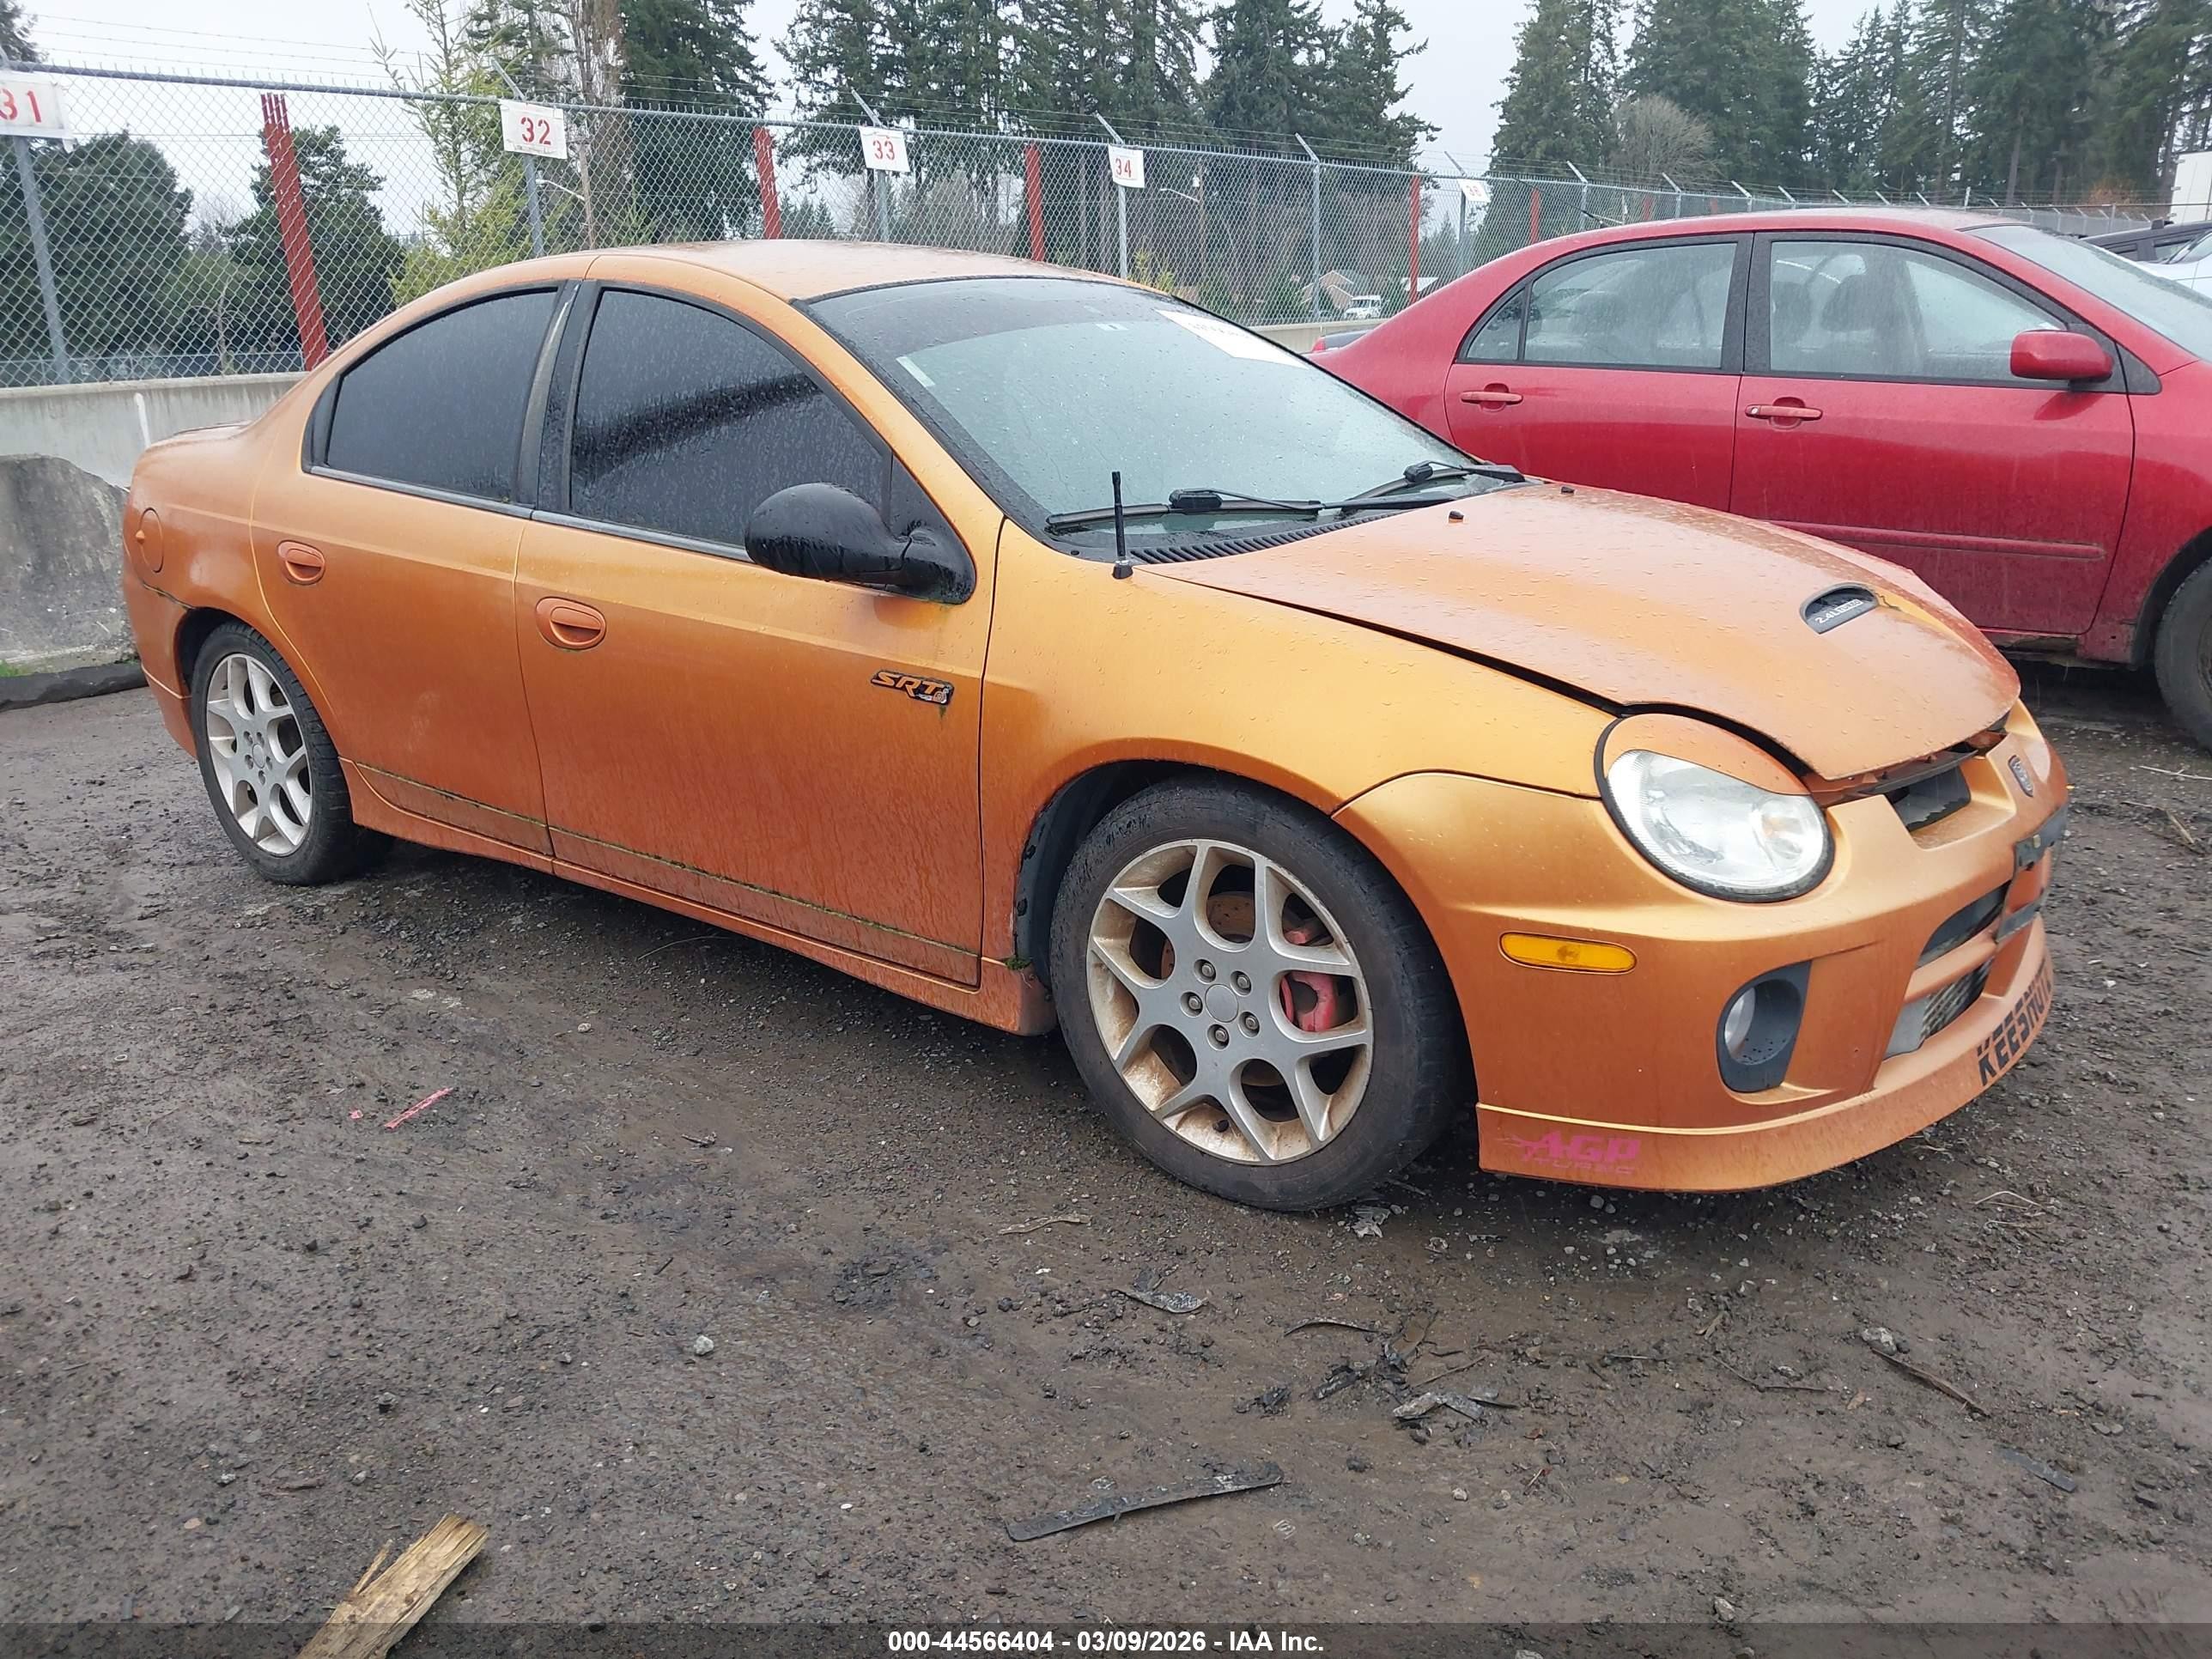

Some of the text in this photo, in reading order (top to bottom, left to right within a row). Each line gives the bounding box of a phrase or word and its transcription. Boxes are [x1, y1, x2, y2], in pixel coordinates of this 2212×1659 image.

[0, 88, 41, 123] 31
[520, 117, 551, 145] 32
[873, 140, 895, 161] 33
[1115, 158, 1132, 178] 34
